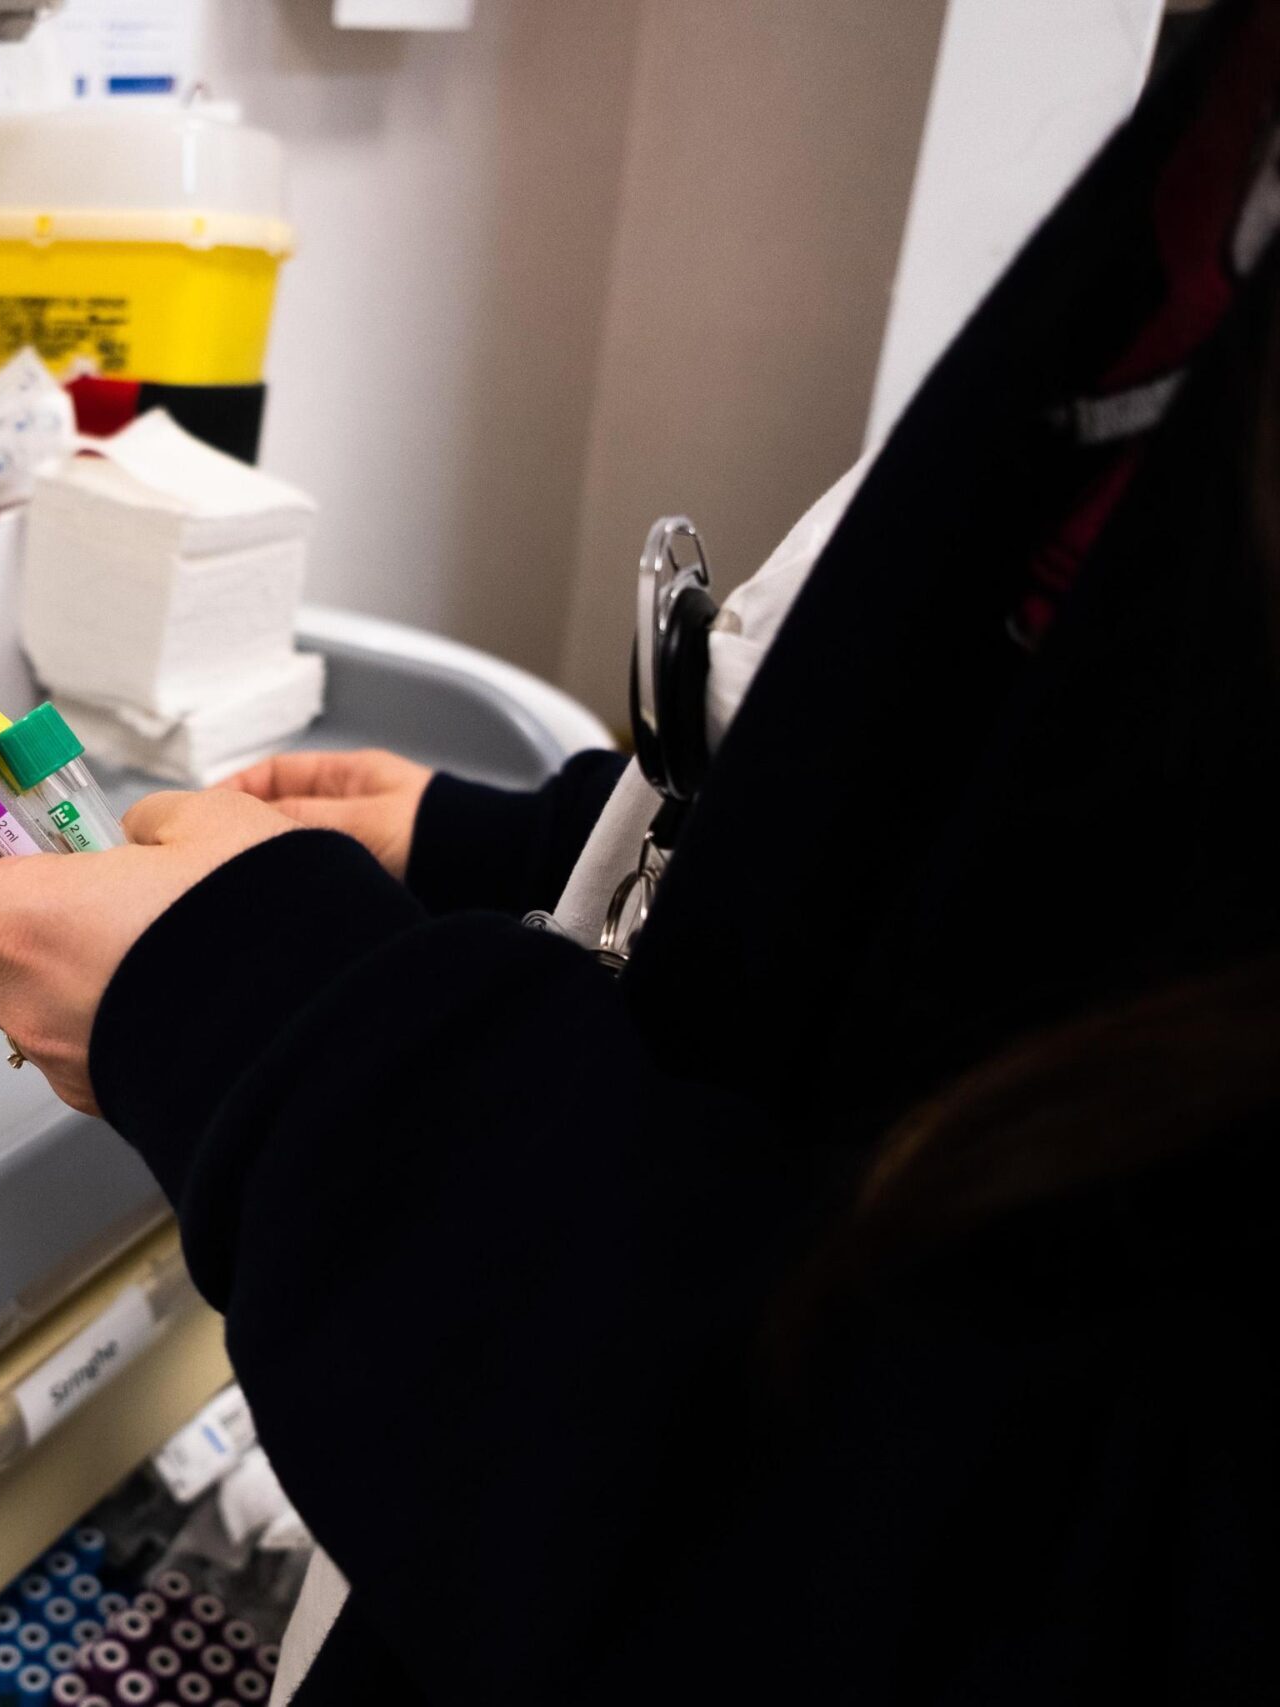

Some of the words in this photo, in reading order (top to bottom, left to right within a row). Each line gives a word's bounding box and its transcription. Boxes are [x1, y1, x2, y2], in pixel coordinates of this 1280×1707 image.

[4, 830, 19, 842] ml
[70, 824, 80, 833] 2
[78, 834, 91, 848] ml
